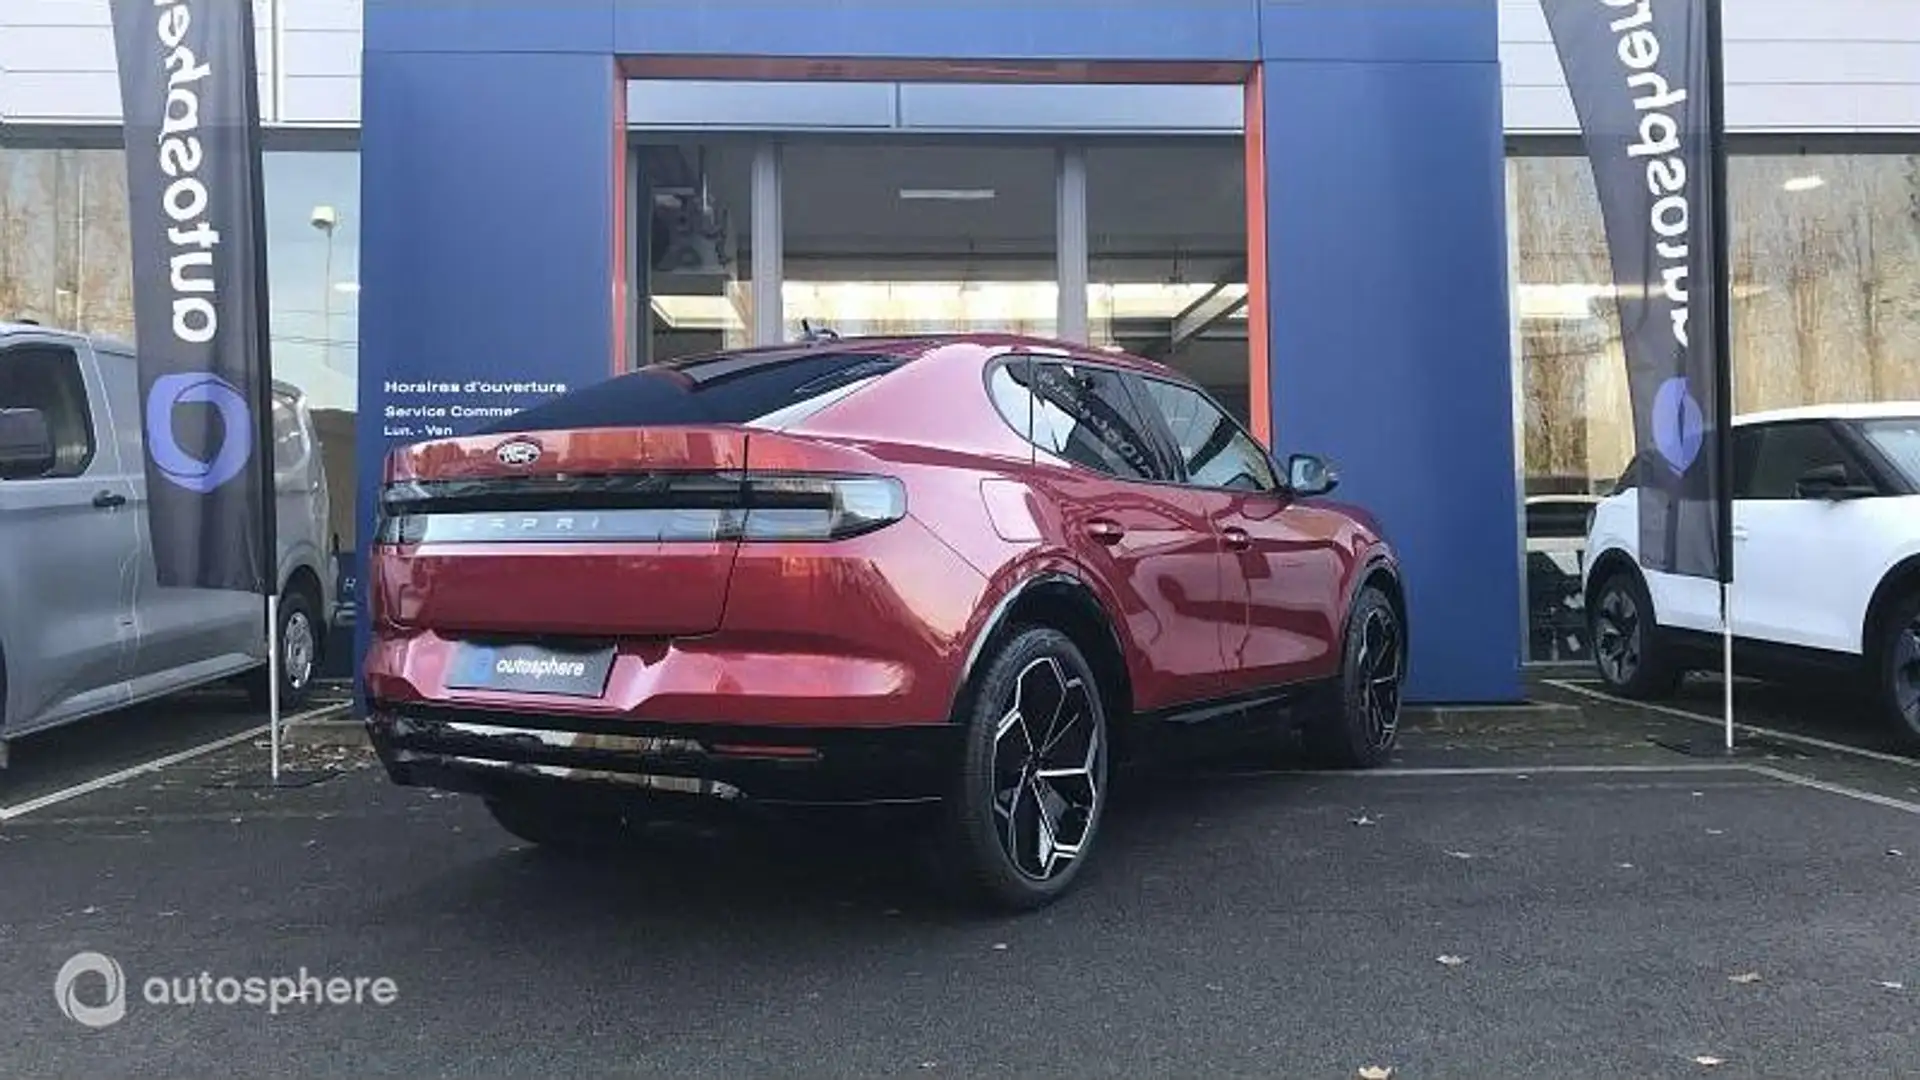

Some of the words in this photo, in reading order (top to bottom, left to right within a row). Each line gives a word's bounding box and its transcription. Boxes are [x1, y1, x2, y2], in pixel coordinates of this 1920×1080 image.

[384, 381, 460, 393] Horaires
[464, 381, 566, 393] d'ouverture
[384, 405, 446, 417] Service
[496, 656, 585, 679] autosphere
